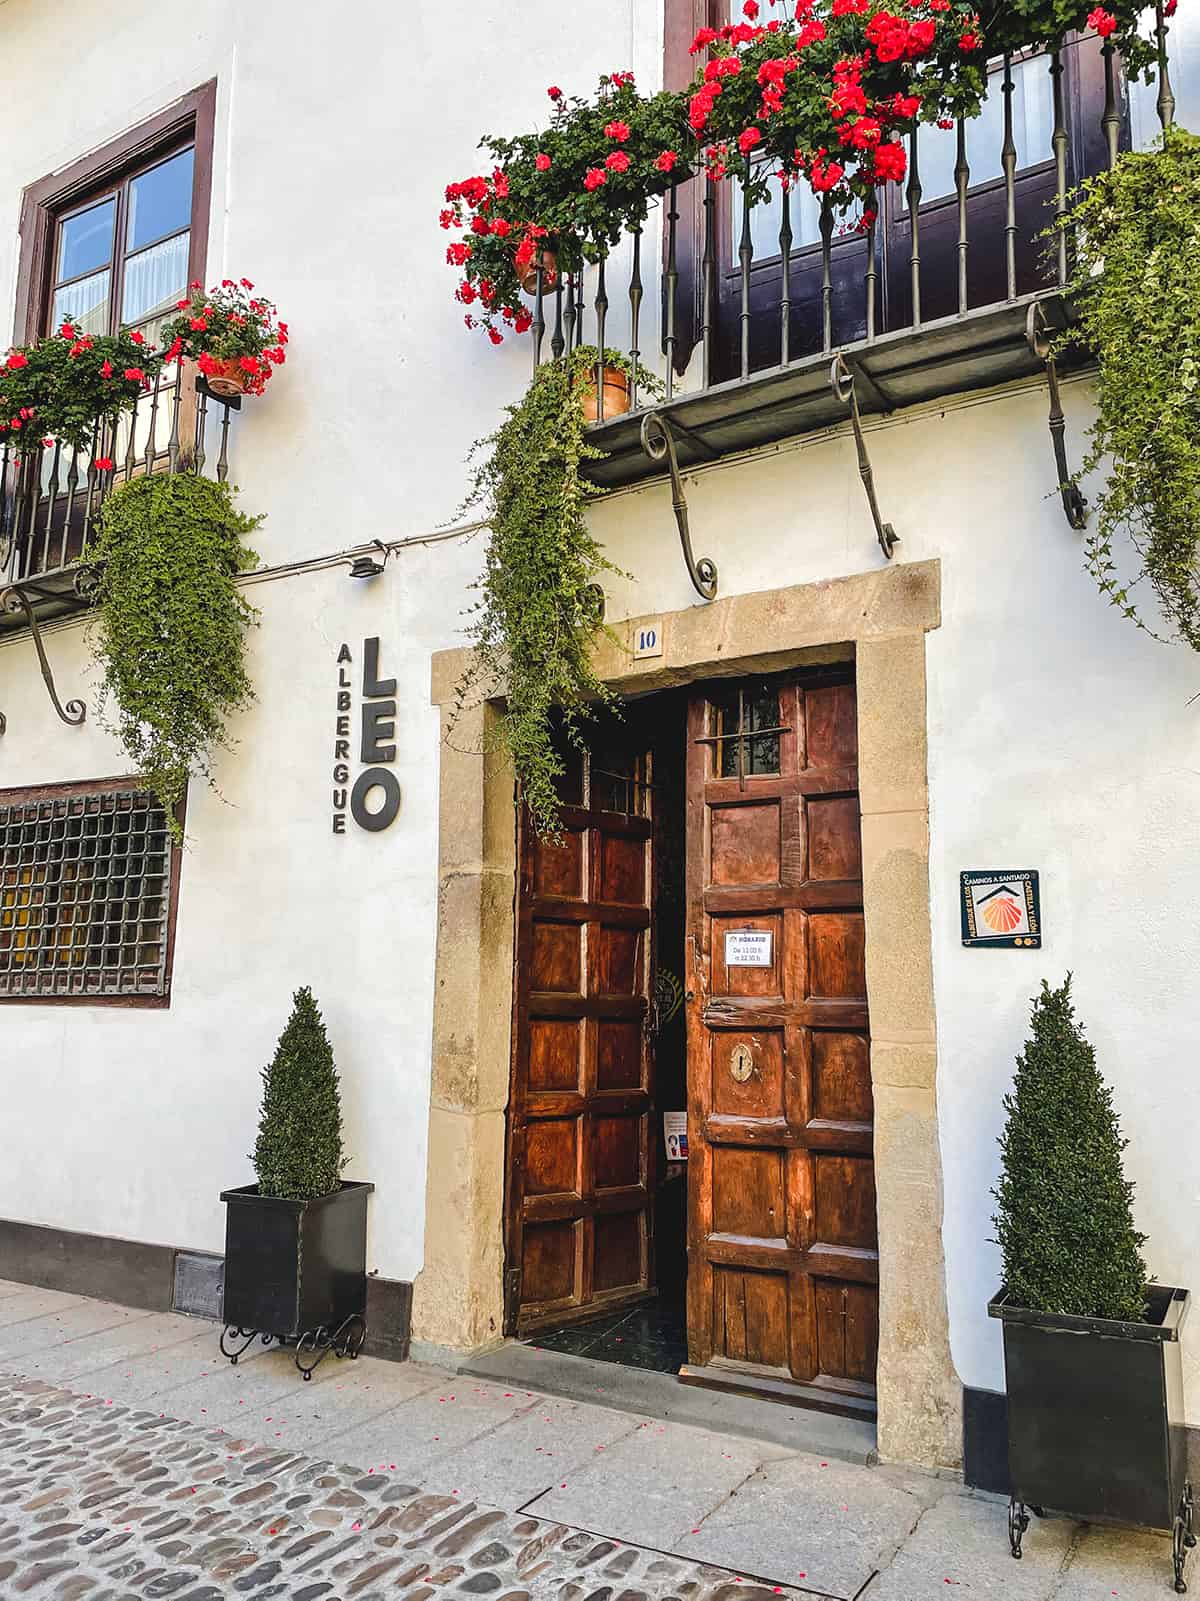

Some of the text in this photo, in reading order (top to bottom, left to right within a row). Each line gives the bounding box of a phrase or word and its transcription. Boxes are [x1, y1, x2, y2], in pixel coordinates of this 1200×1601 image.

[640, 630, 656, 650] 10
[333, 643, 353, 834] ALBERGUE
[350, 636, 401, 833] LEO
[964, 876, 992, 885] CAMINOS
[999, 873, 1030, 882] SANTIAGO
[1025, 880, 1034, 911] CASTILLA
[967, 908, 977, 938] ALBERGUE
[1029, 916, 1038, 933] LEÓN
